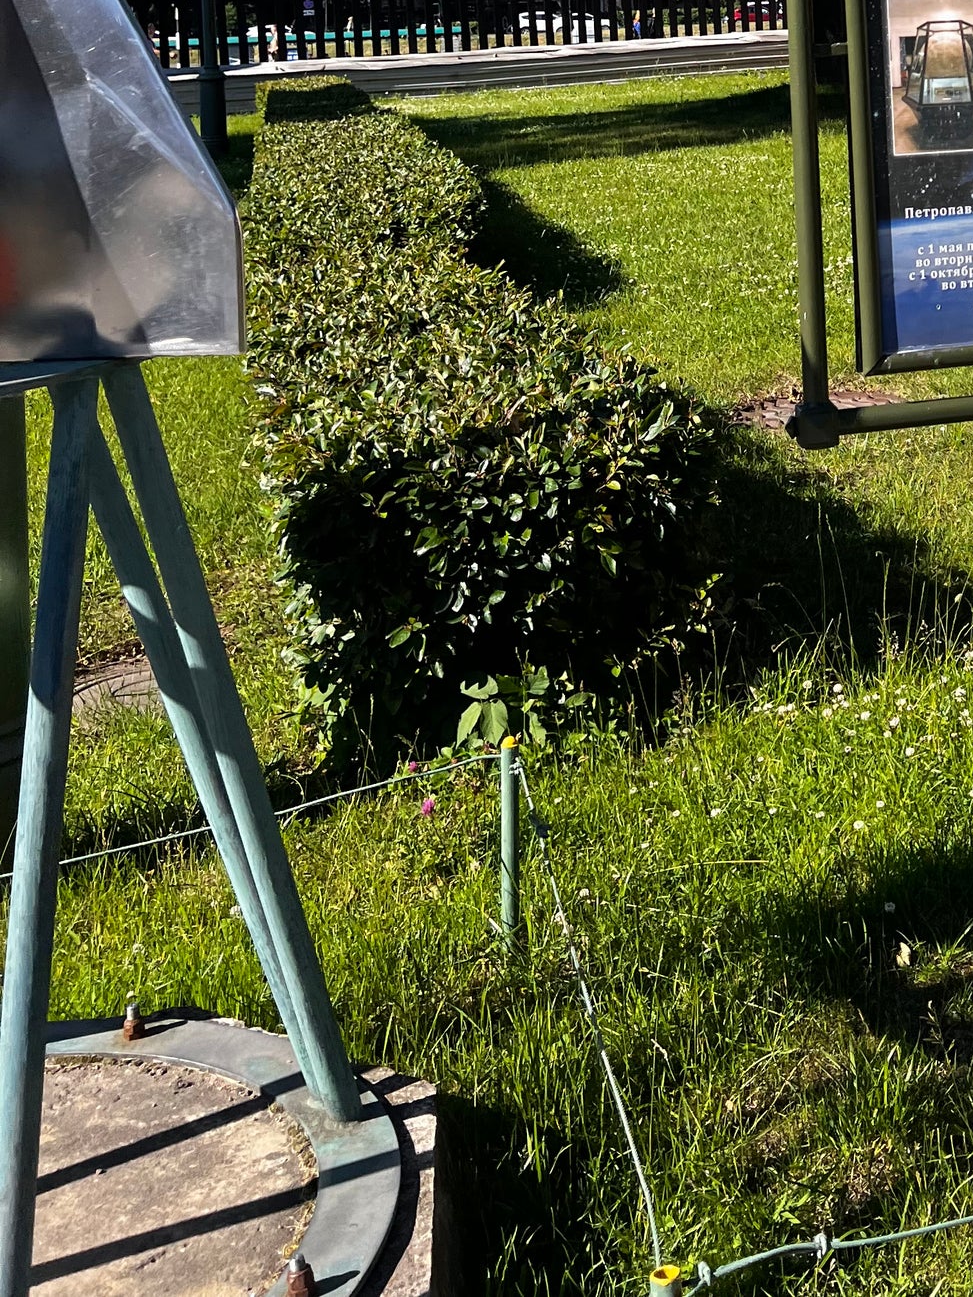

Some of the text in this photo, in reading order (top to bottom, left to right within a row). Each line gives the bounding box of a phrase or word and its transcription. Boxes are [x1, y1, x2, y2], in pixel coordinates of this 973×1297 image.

[918, 246, 924, 255] с
[928, 244, 935, 254] 1
[939, 244, 963, 254] мая
[915, 258, 930, 268] во
[908, 272, 915, 281] с
[919, 269, 927, 280] 1
[941, 280, 957, 291] во
